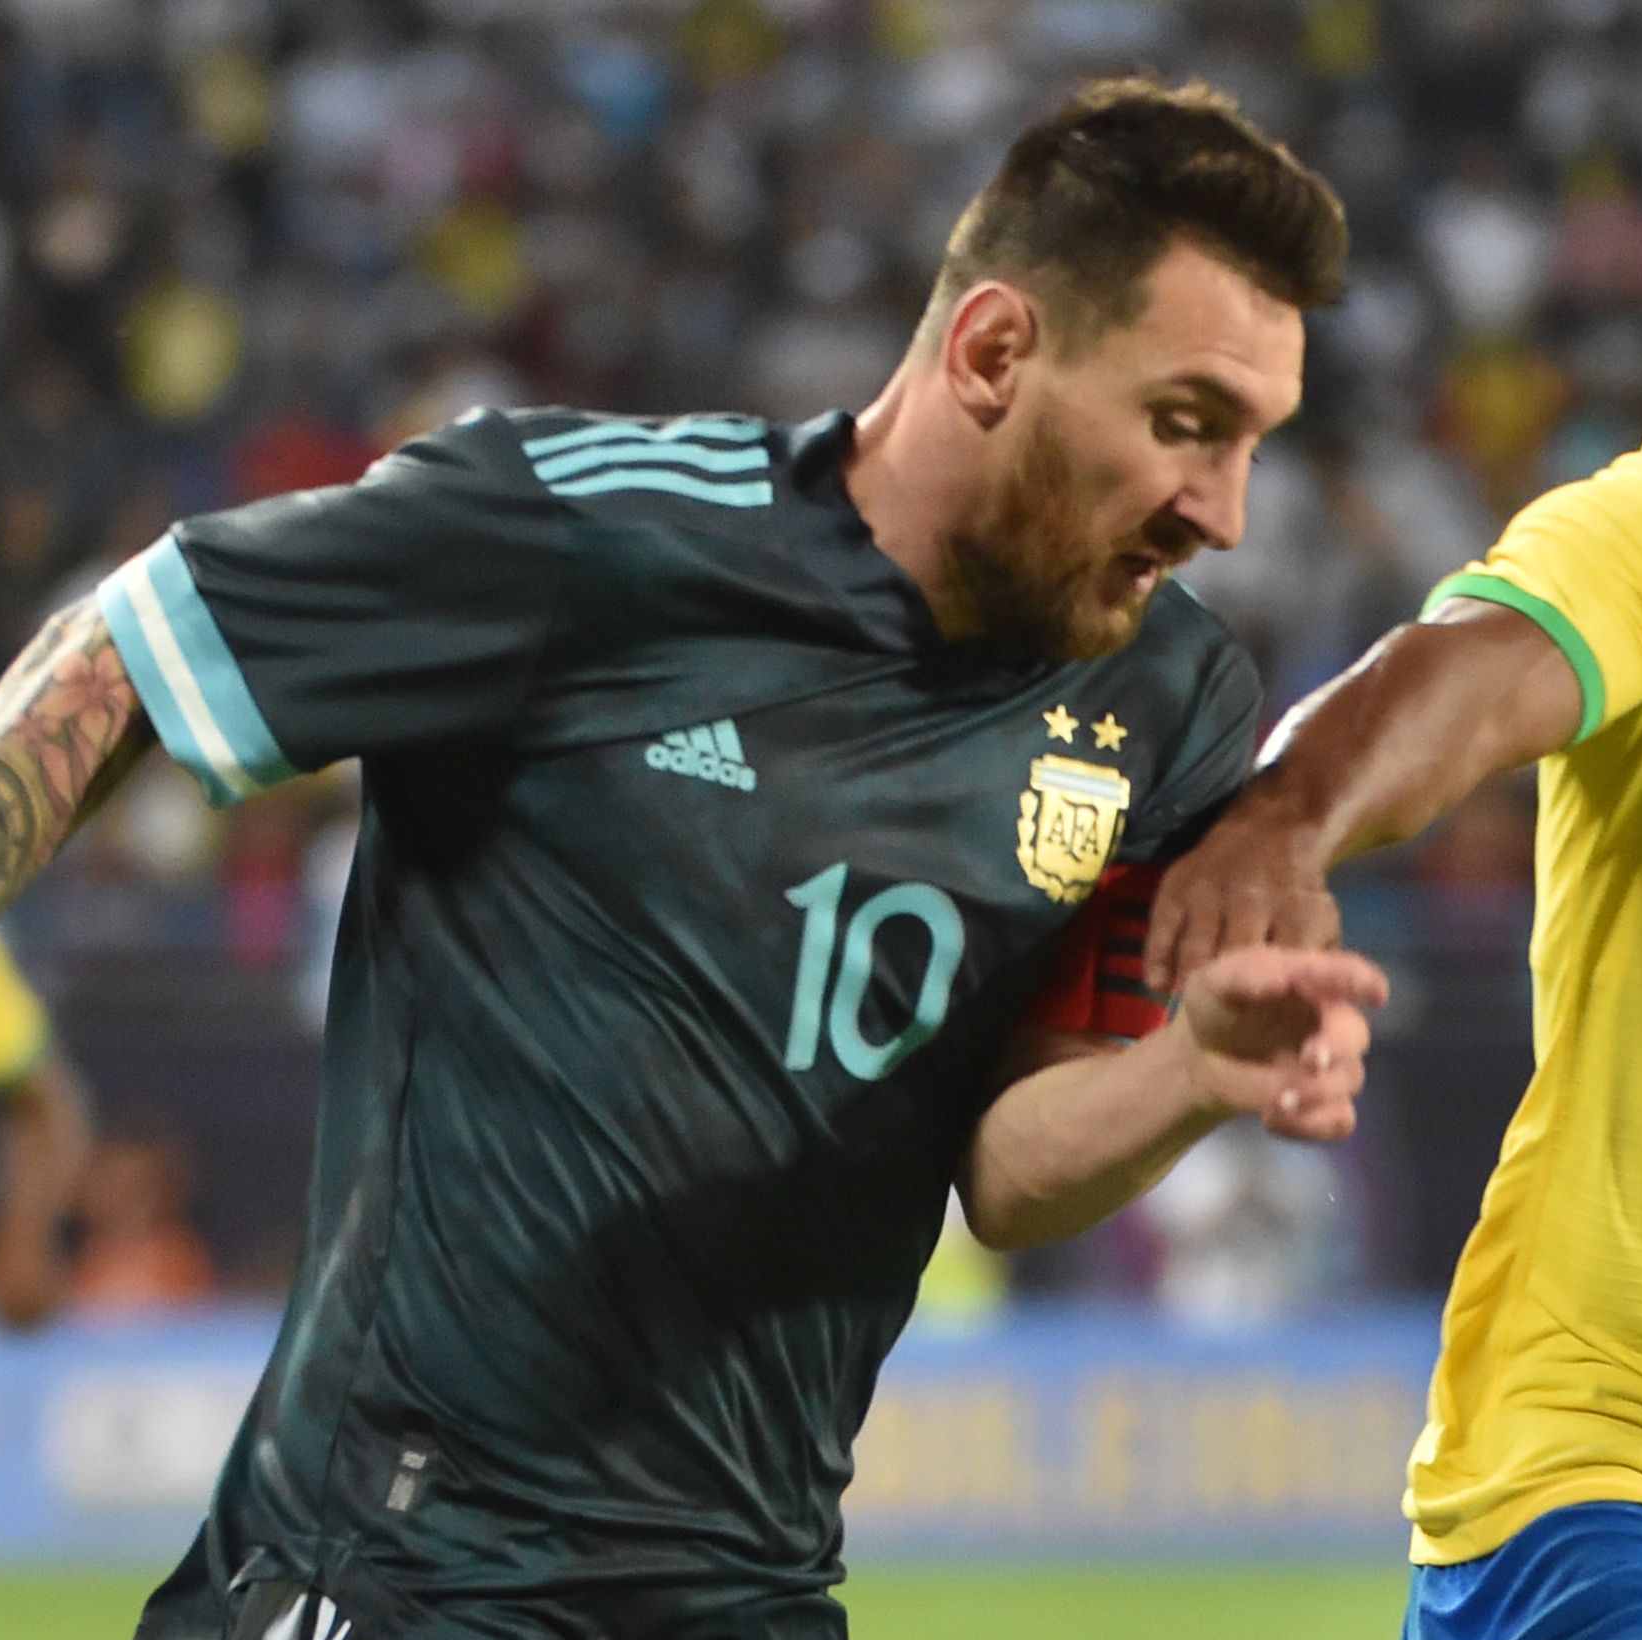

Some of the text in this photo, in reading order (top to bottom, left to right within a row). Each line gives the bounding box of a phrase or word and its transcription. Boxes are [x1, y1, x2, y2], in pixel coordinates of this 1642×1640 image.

[644, 742, 757, 792] adidas
[1045, 795, 1099, 864] AFA
[782, 861, 965, 1082] 10
